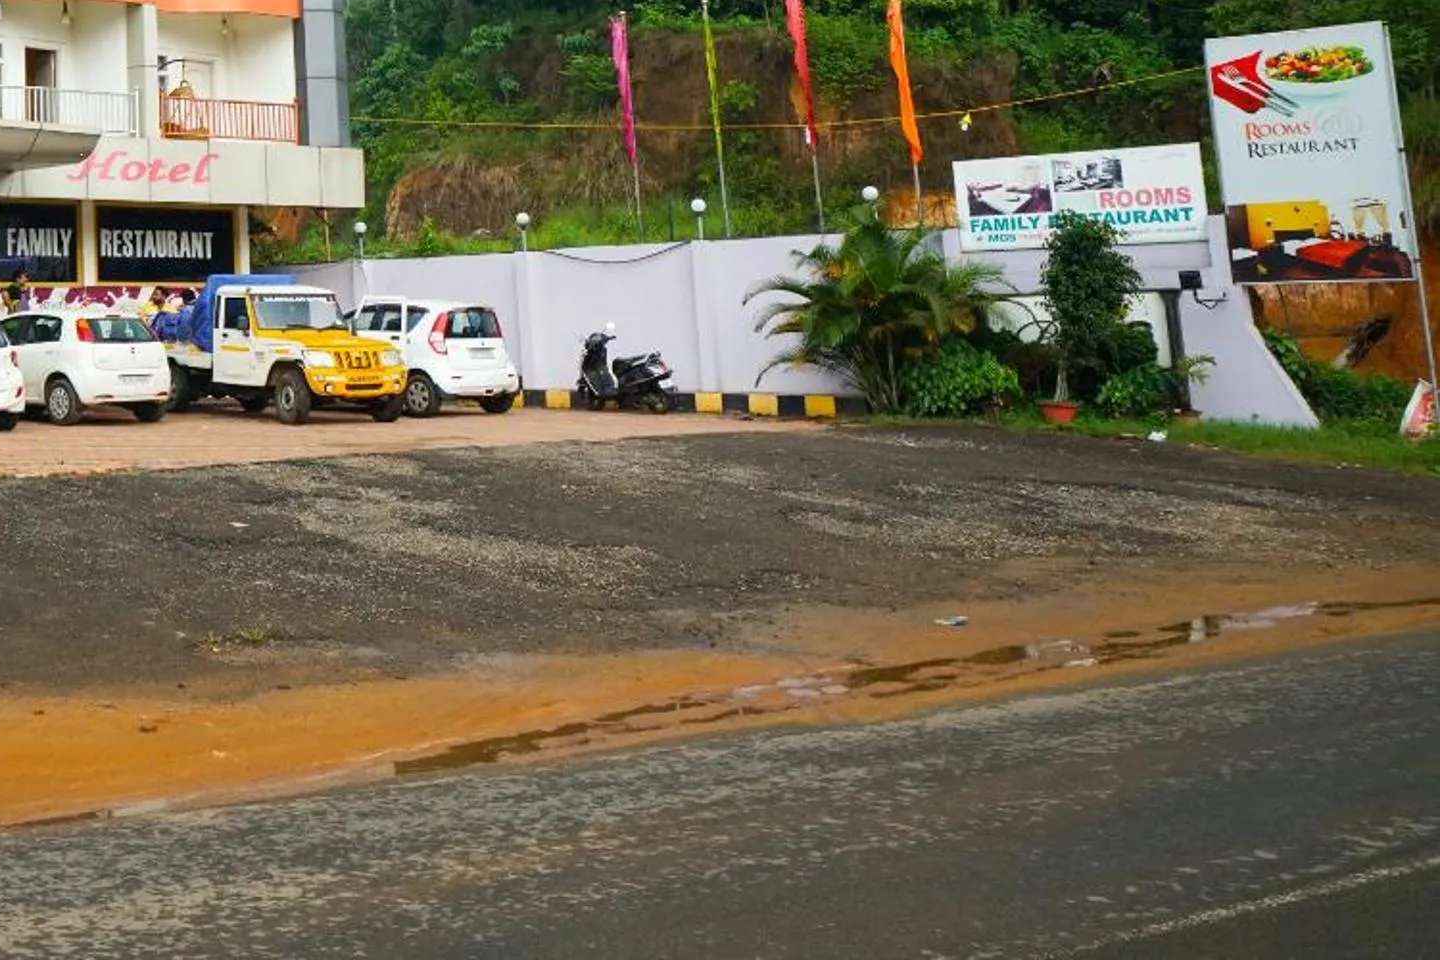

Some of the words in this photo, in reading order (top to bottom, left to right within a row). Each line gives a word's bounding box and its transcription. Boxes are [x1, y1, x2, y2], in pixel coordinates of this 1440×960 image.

[1245, 121, 1311, 141] ROOMS
[1247, 137, 1360, 158] RESTAURANT
[66, 150, 219, 184] Hotel
[1100, 186, 1193, 209] ROOMS
[970, 215, 1040, 233] FAMILY
[6, 227, 73, 257] FAMILY
[100, 229, 214, 260] RESTAURANT
